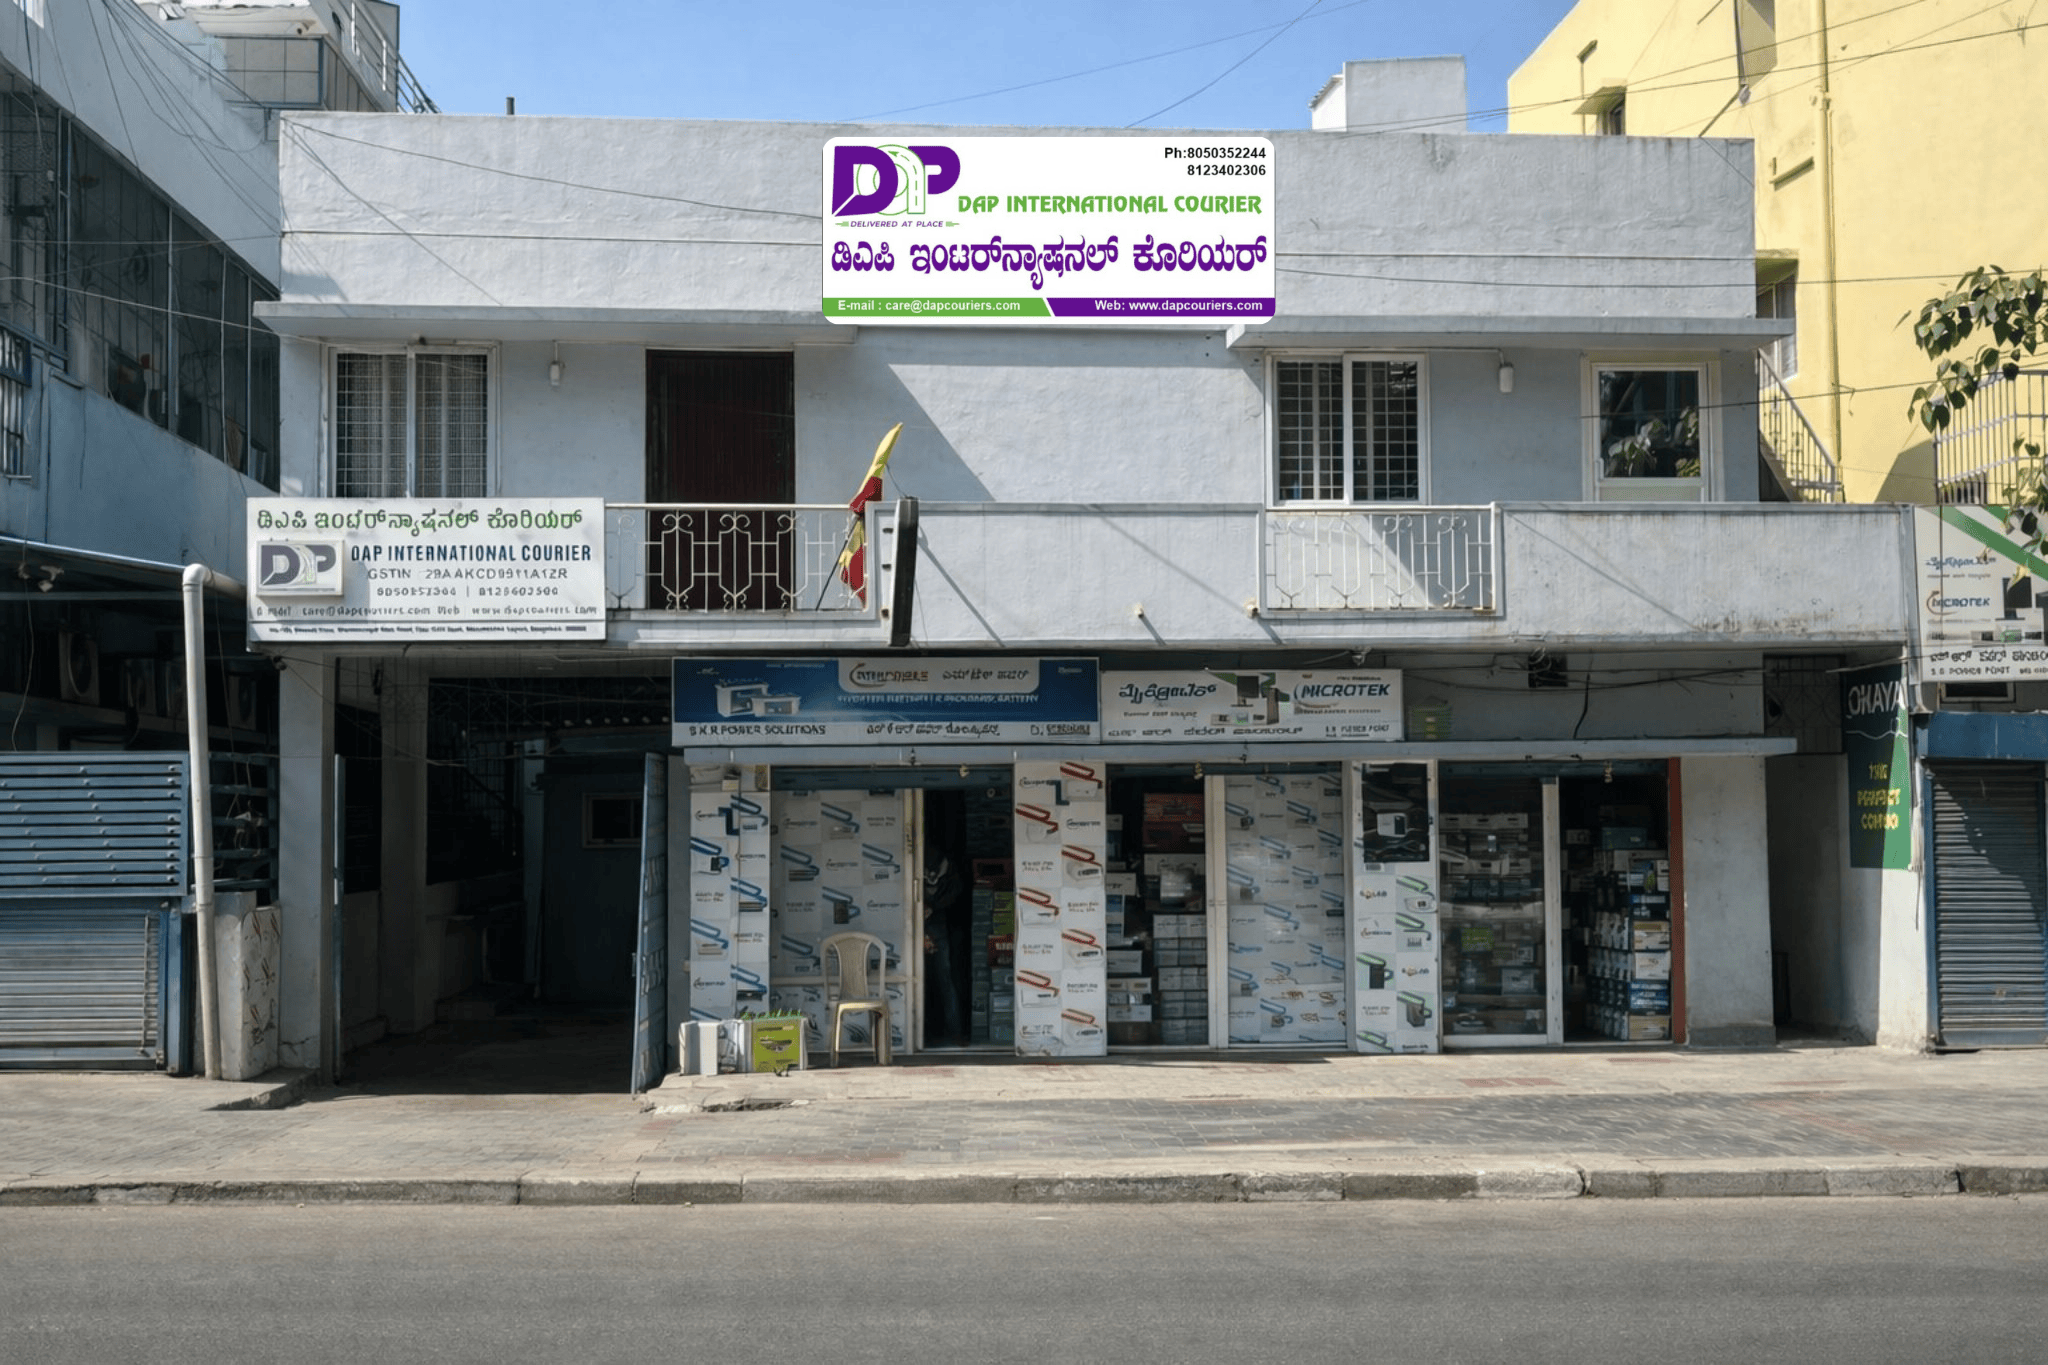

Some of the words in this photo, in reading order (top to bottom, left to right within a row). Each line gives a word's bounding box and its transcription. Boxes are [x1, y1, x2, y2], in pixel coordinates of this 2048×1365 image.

[1164, 146, 1267, 159] Ph:8050352244
[1186, 164, 1267, 176] 8123402306
[958, 196, 999, 214] DAP
[1007, 195, 1168, 215] INTERNATIONAL
[1174, 195, 1262, 215] COURIER
[850, 220, 898, 228] DELIVERED
[902, 220, 913, 228] AT
[916, 220, 943, 228] PLACE
[831, 235, 894, 272] ಡಿಎಪಿ
[1133, 234, 1268, 272] ಕೊರಿಯರ್
[838, 299, 874, 311] E-mail
[886, 299, 1021, 314] care@dapcouriers.com
[1095, 299, 1125, 311] Web:
[1129, 299, 1263, 314] www.dapcouriers.com
[351, 544, 382, 561] DAP
[388, 544, 516, 561] INTERNATIONAL
[521, 544, 592, 561] COURIER
[367, 567, 411, 580] GSTIN
[1848, 680, 1908, 715] OKAYA
